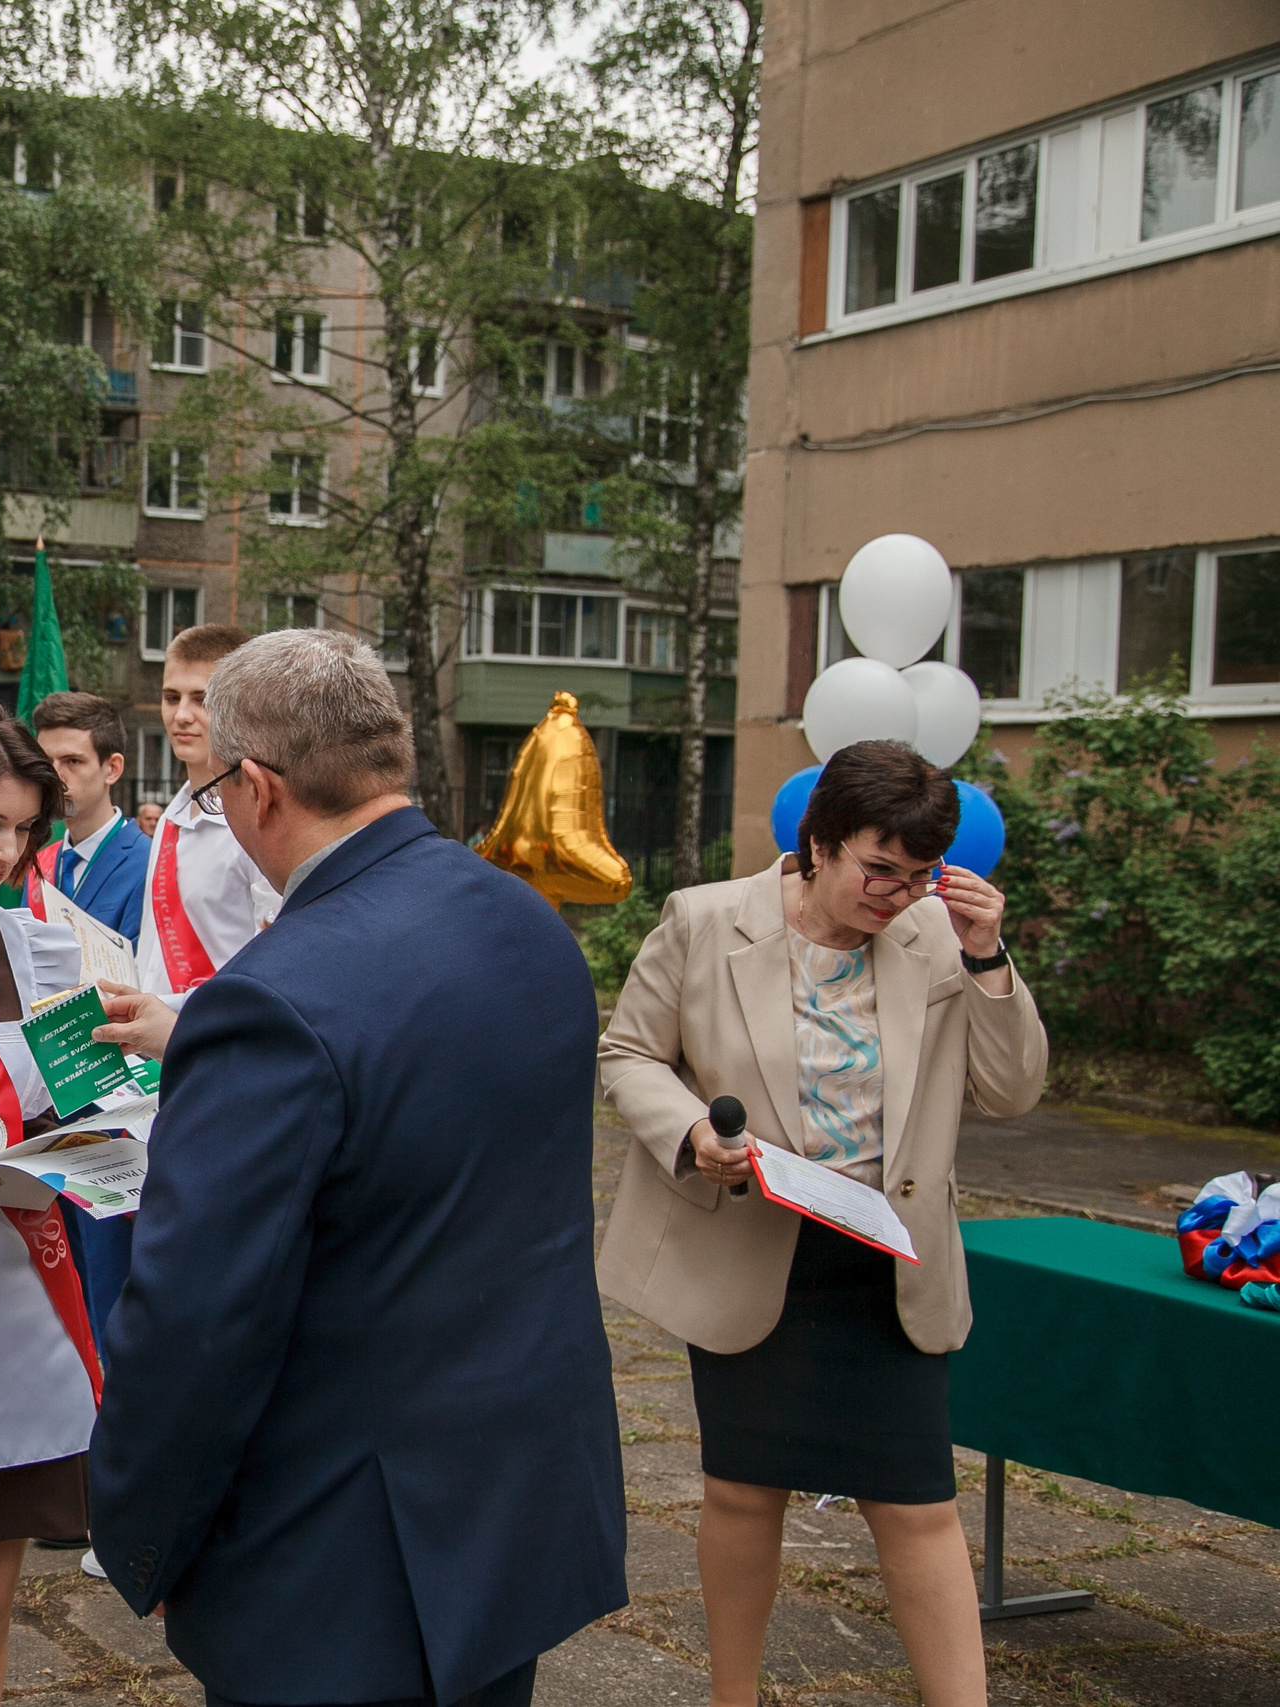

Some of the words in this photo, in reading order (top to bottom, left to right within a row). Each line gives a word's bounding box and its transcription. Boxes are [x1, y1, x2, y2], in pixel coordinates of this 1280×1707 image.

[154, 841, 192, 976] Выпускник
[39, 1018, 78, 1043] СДЕЛАЙТЕ
[57, 1040, 67, 1048] ЗА
[68, 1029, 85, 1041] ЧТО
[48, 1054, 70, 1068] ВАШЕ
[74, 1058, 89, 1070] ВАС
[88, 1168, 146, 1186] ГРАМОТА
